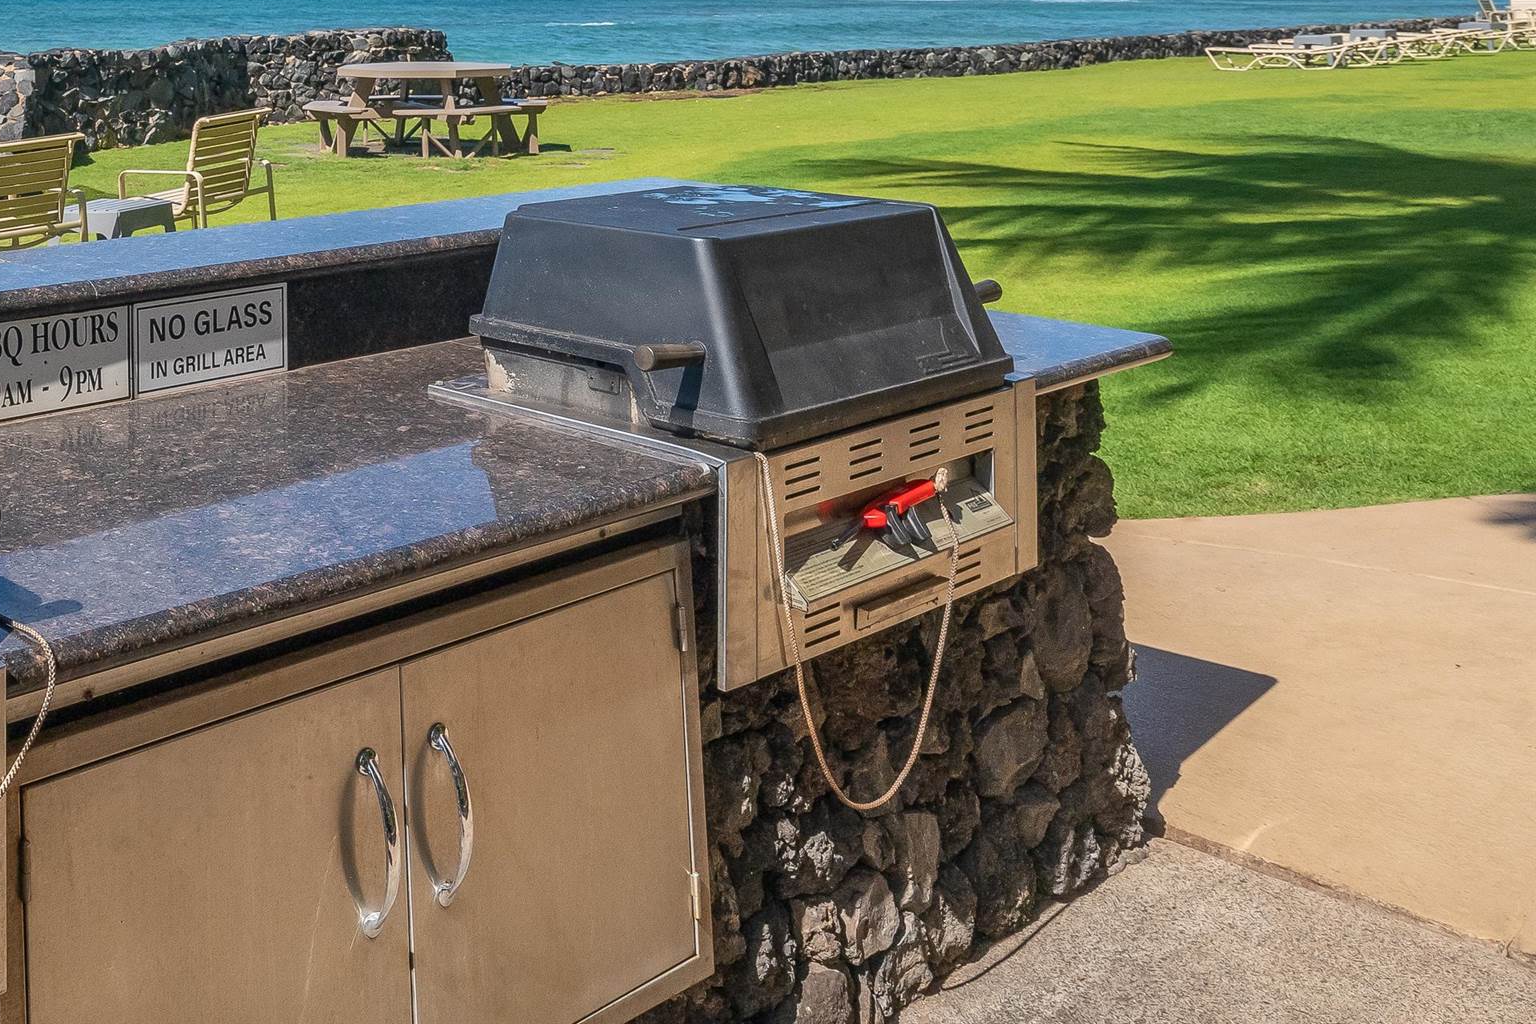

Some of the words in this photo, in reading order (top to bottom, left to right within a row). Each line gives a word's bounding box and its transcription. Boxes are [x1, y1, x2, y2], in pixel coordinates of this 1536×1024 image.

[31, 311, 119, 354] HOURS
[149, 314, 186, 344] NO
[194, 300, 273, 336] GLASS
[151, 360, 168, 379] IN
[173, 351, 221, 375] GRILL
[224, 343, 266, 367] AREA
[59, 365, 104, 403] 9PM
